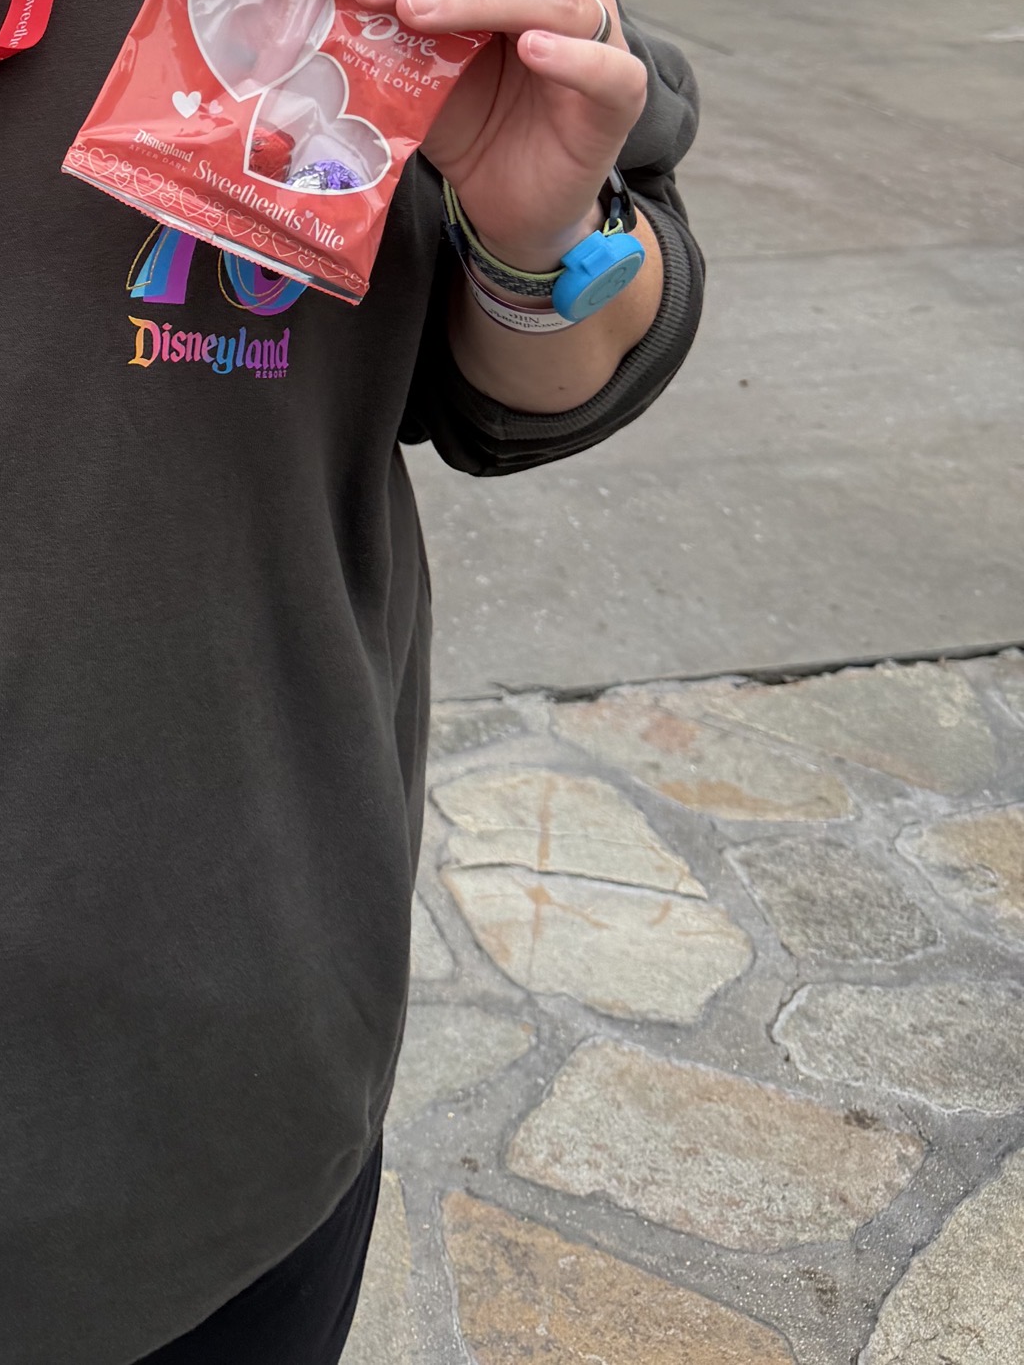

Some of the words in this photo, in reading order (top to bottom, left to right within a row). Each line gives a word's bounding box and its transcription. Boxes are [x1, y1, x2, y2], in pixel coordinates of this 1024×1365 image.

[336, 34, 394, 68] ALWAYS
[398, 64, 440, 91] MADE
[342, 51, 381, 78] WITH
[383, 73, 422, 98] LOVE
[128, 144, 159, 161] AFTER
[162, 156, 189, 173] DARK
[133, 129, 194, 163] Disneyland
[307, 217, 345, 252] Nite
[127, 315, 291, 375] Disneyland
[254, 369, 288, 379] RESORT
